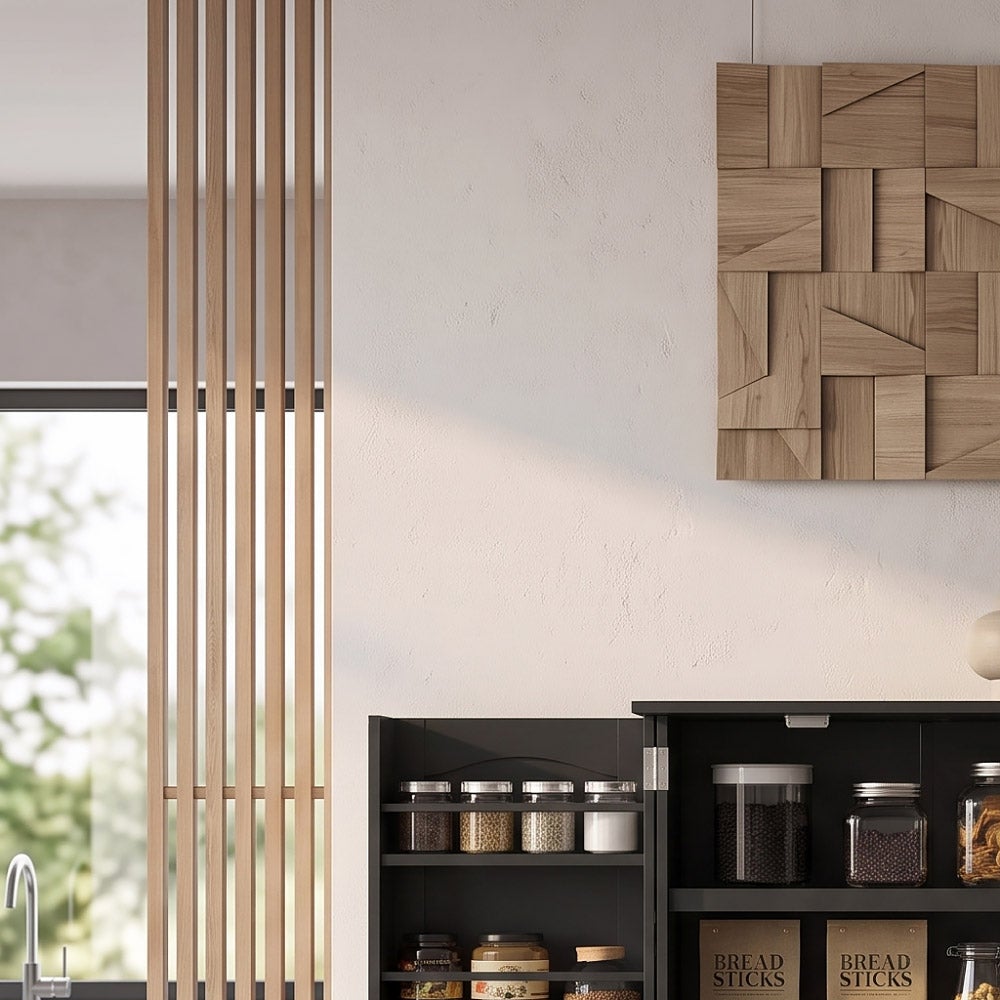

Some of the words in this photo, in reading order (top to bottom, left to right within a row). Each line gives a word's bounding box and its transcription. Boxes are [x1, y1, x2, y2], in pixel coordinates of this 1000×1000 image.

[714, 953, 784, 970] BREAD
[841, 953, 911, 970] BREAD
[713, 971, 785, 988] STICKS
[840, 971, 912, 988] STICKS
